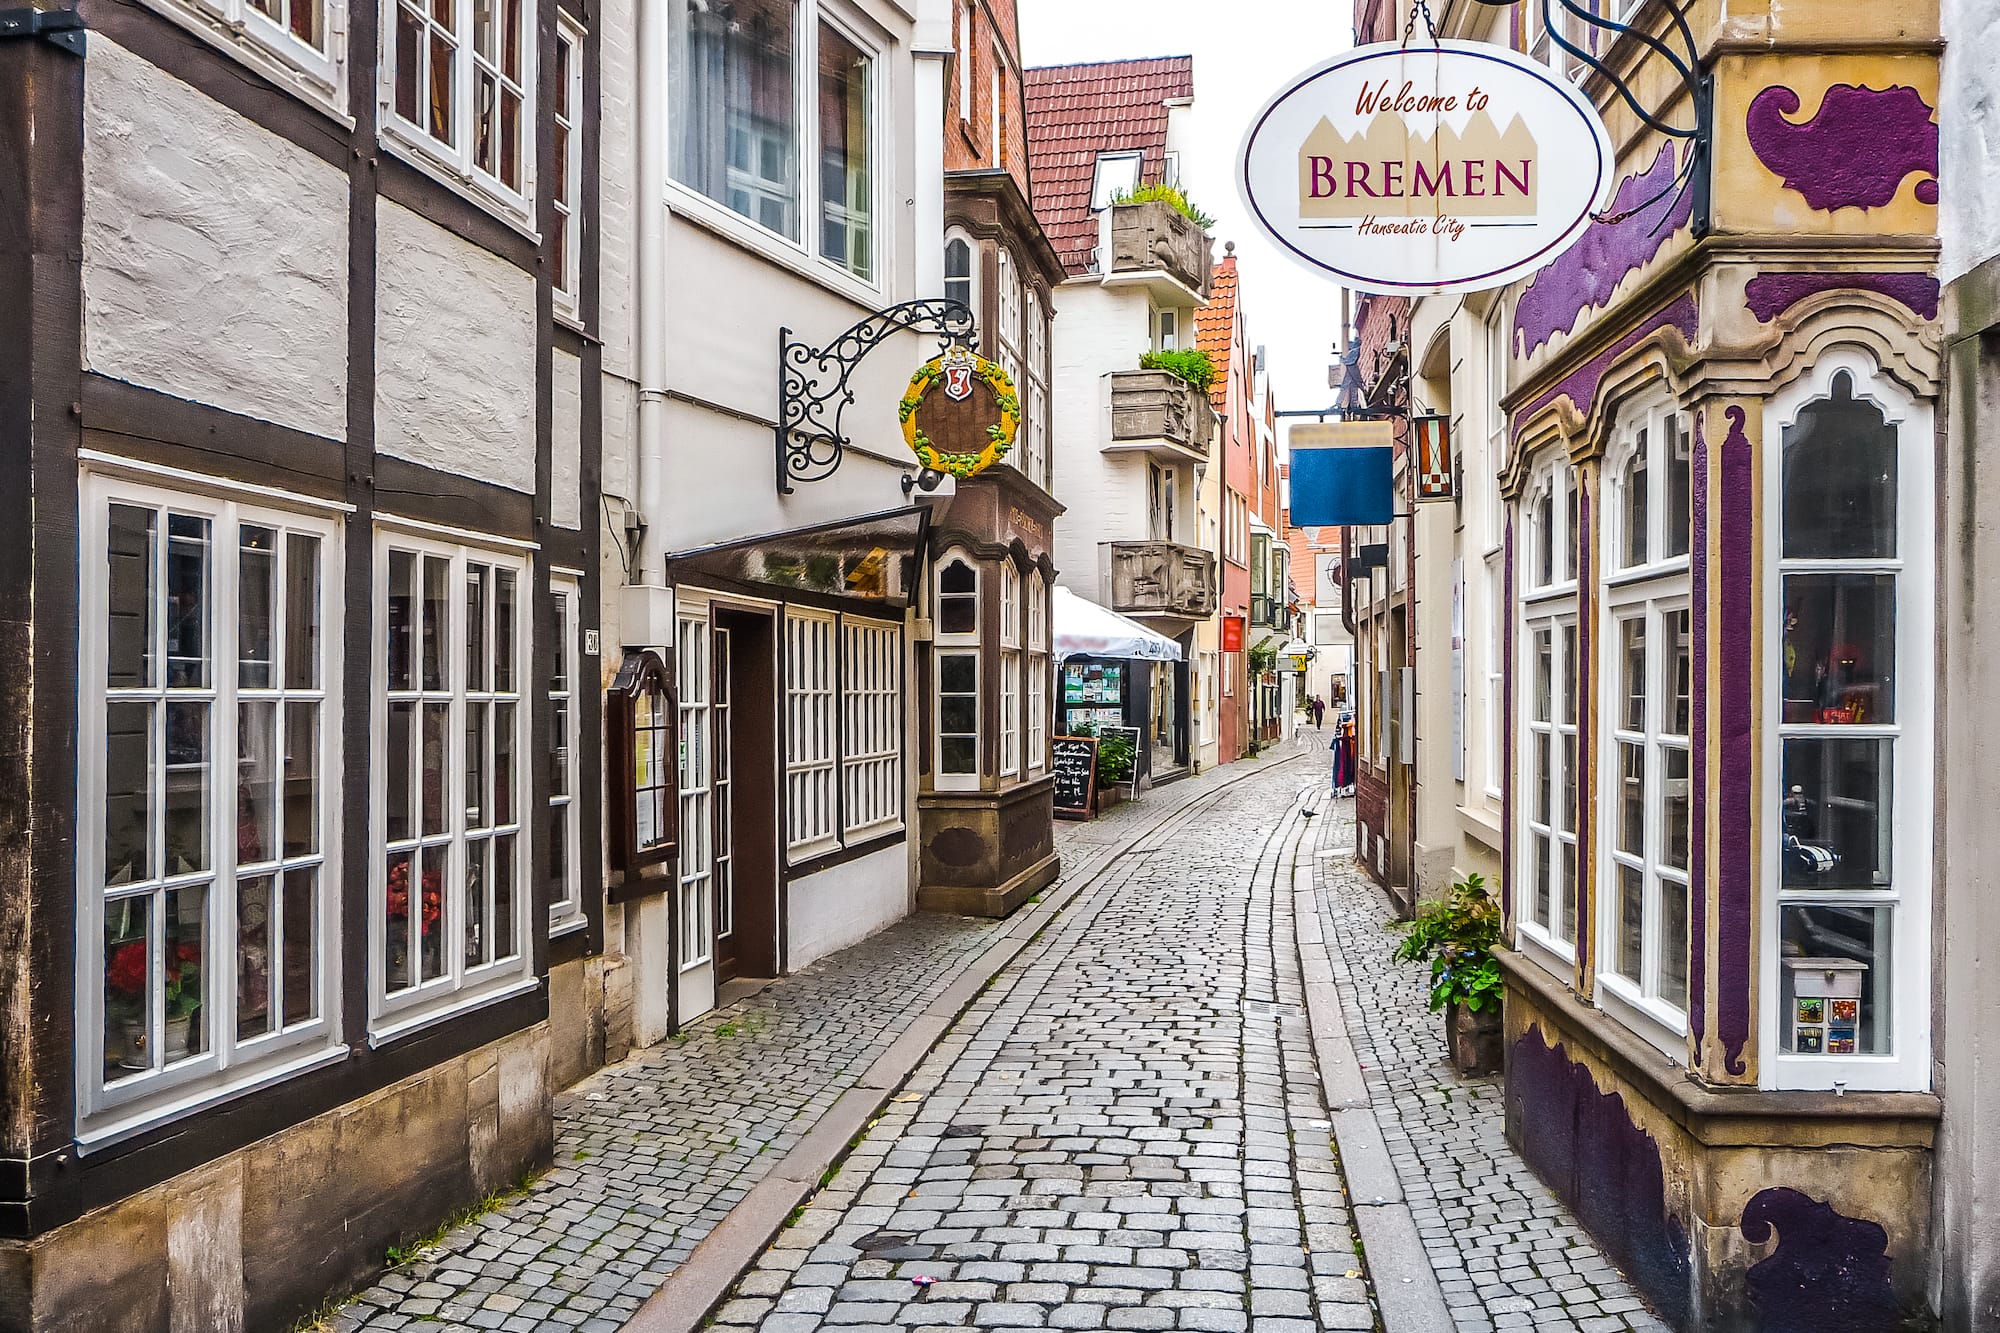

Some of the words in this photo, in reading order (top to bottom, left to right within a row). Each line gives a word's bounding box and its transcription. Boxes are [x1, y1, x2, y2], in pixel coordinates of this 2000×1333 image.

[1355, 79, 1457, 116] Welcome
[1466, 86, 1489, 111] to
[1307, 156, 1532, 198] BREMEN
[1358, 214, 1427, 236] Hanseatic
[1432, 213, 1465, 242] City
